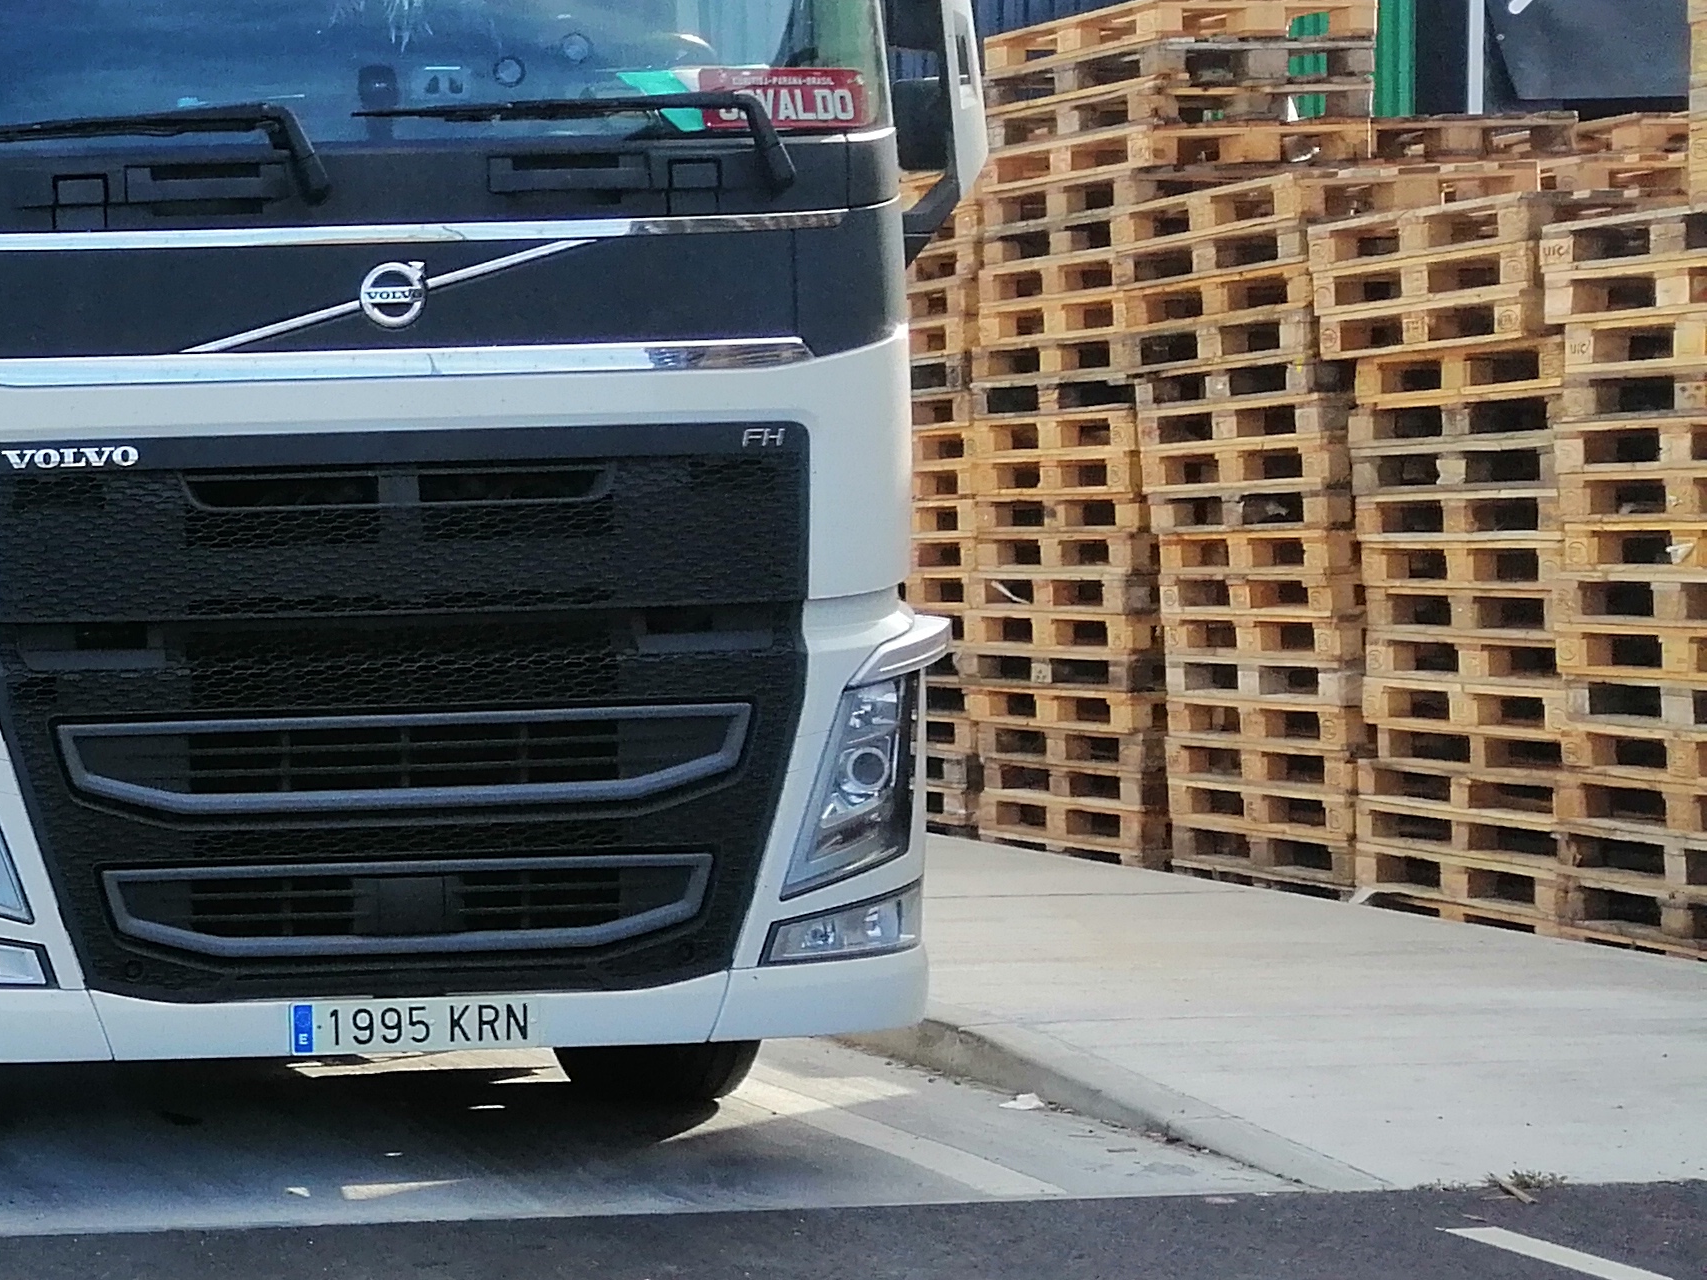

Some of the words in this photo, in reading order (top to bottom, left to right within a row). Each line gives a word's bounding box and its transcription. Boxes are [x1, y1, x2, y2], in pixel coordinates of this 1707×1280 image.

[364, 290, 423, 300] VOLVO
[742, 428, 786, 446] FH
[1, 445, 139, 469] VOLVO
[298, 1033, 308, 1045] E
[329, 1006, 430, 1046] 1995
[449, 1003, 528, 1042] KRN
